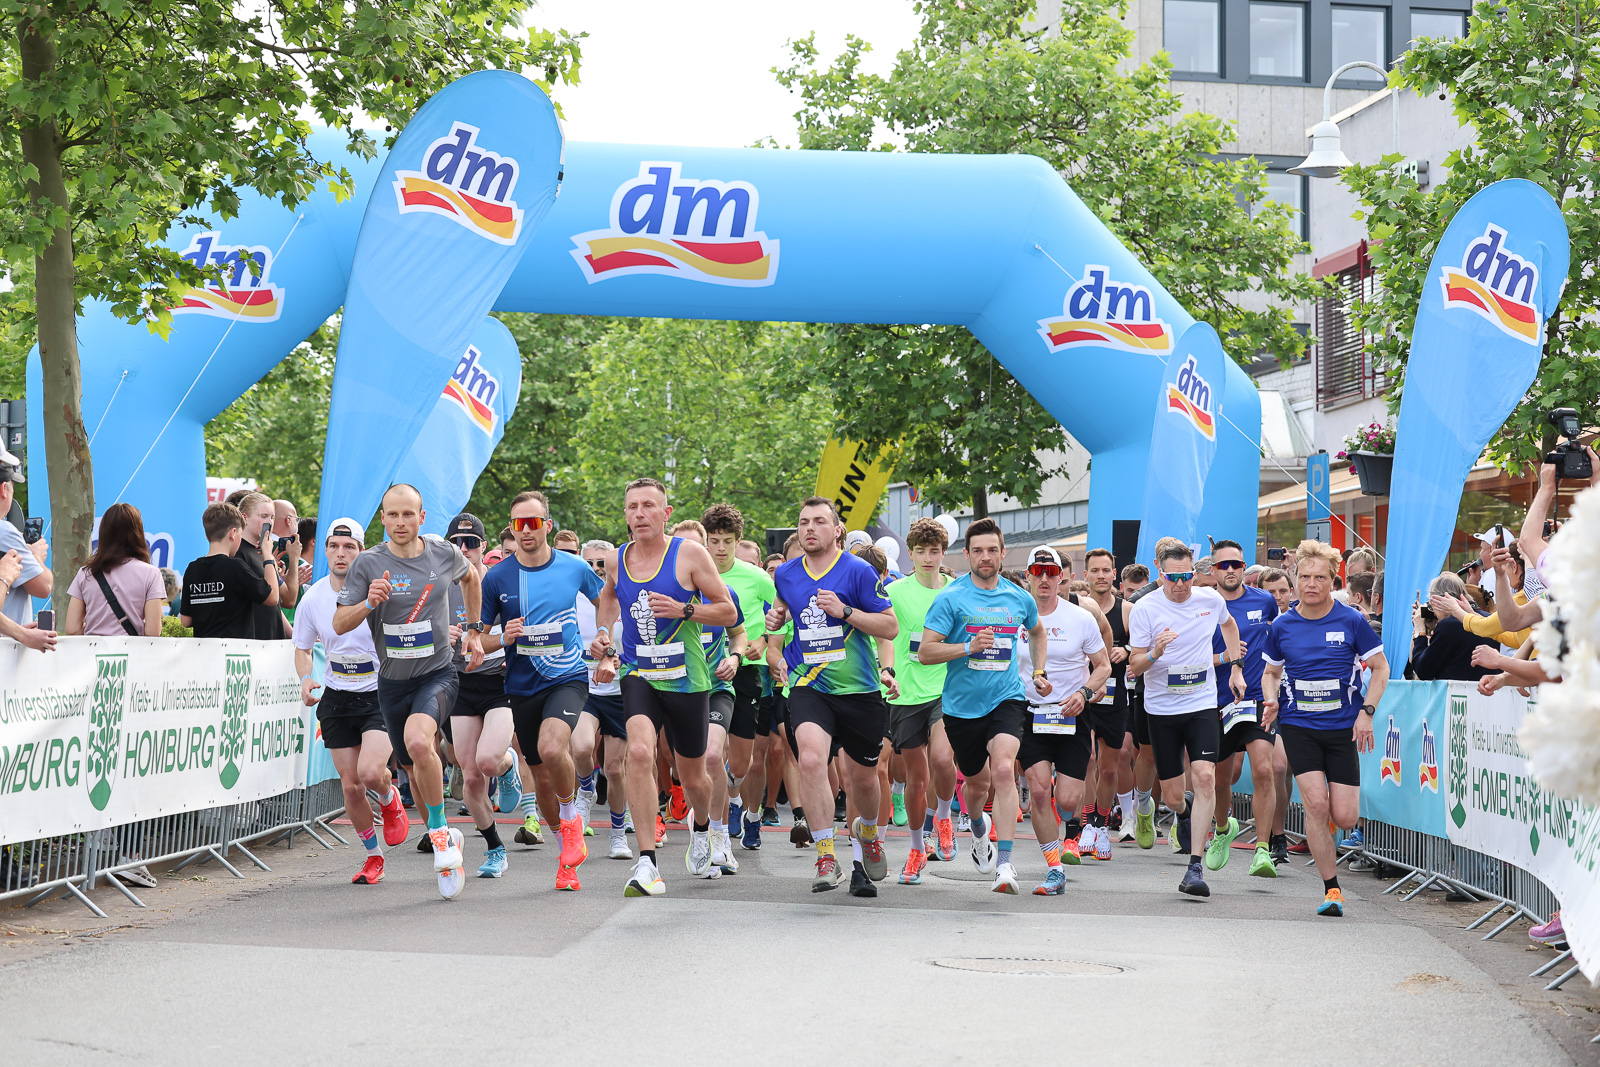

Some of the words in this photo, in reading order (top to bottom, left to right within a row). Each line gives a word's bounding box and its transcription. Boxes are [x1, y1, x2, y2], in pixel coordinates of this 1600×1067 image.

[427, 130, 513, 202] dm
[619, 167, 749, 237] dm
[1466, 230, 1534, 303] dm
[1070, 271, 1150, 321] dm
[453, 349, 495, 406] dm
[1178, 359, 1209, 411] dm
[1312, 464, 1324, 511] P
[808, 640, 832, 648] Jeremy
[129, 682, 151, 713] Kreis-
[161, 680, 221, 711] Universitätsstadt
[124, 724, 215, 779] HOMBURG
[251, 716, 304, 763] HOMBURG
[1386, 719, 1400, 759] dm
[1423, 722, 1435, 764] dm
[1473, 767, 1527, 825] HOMBURG
